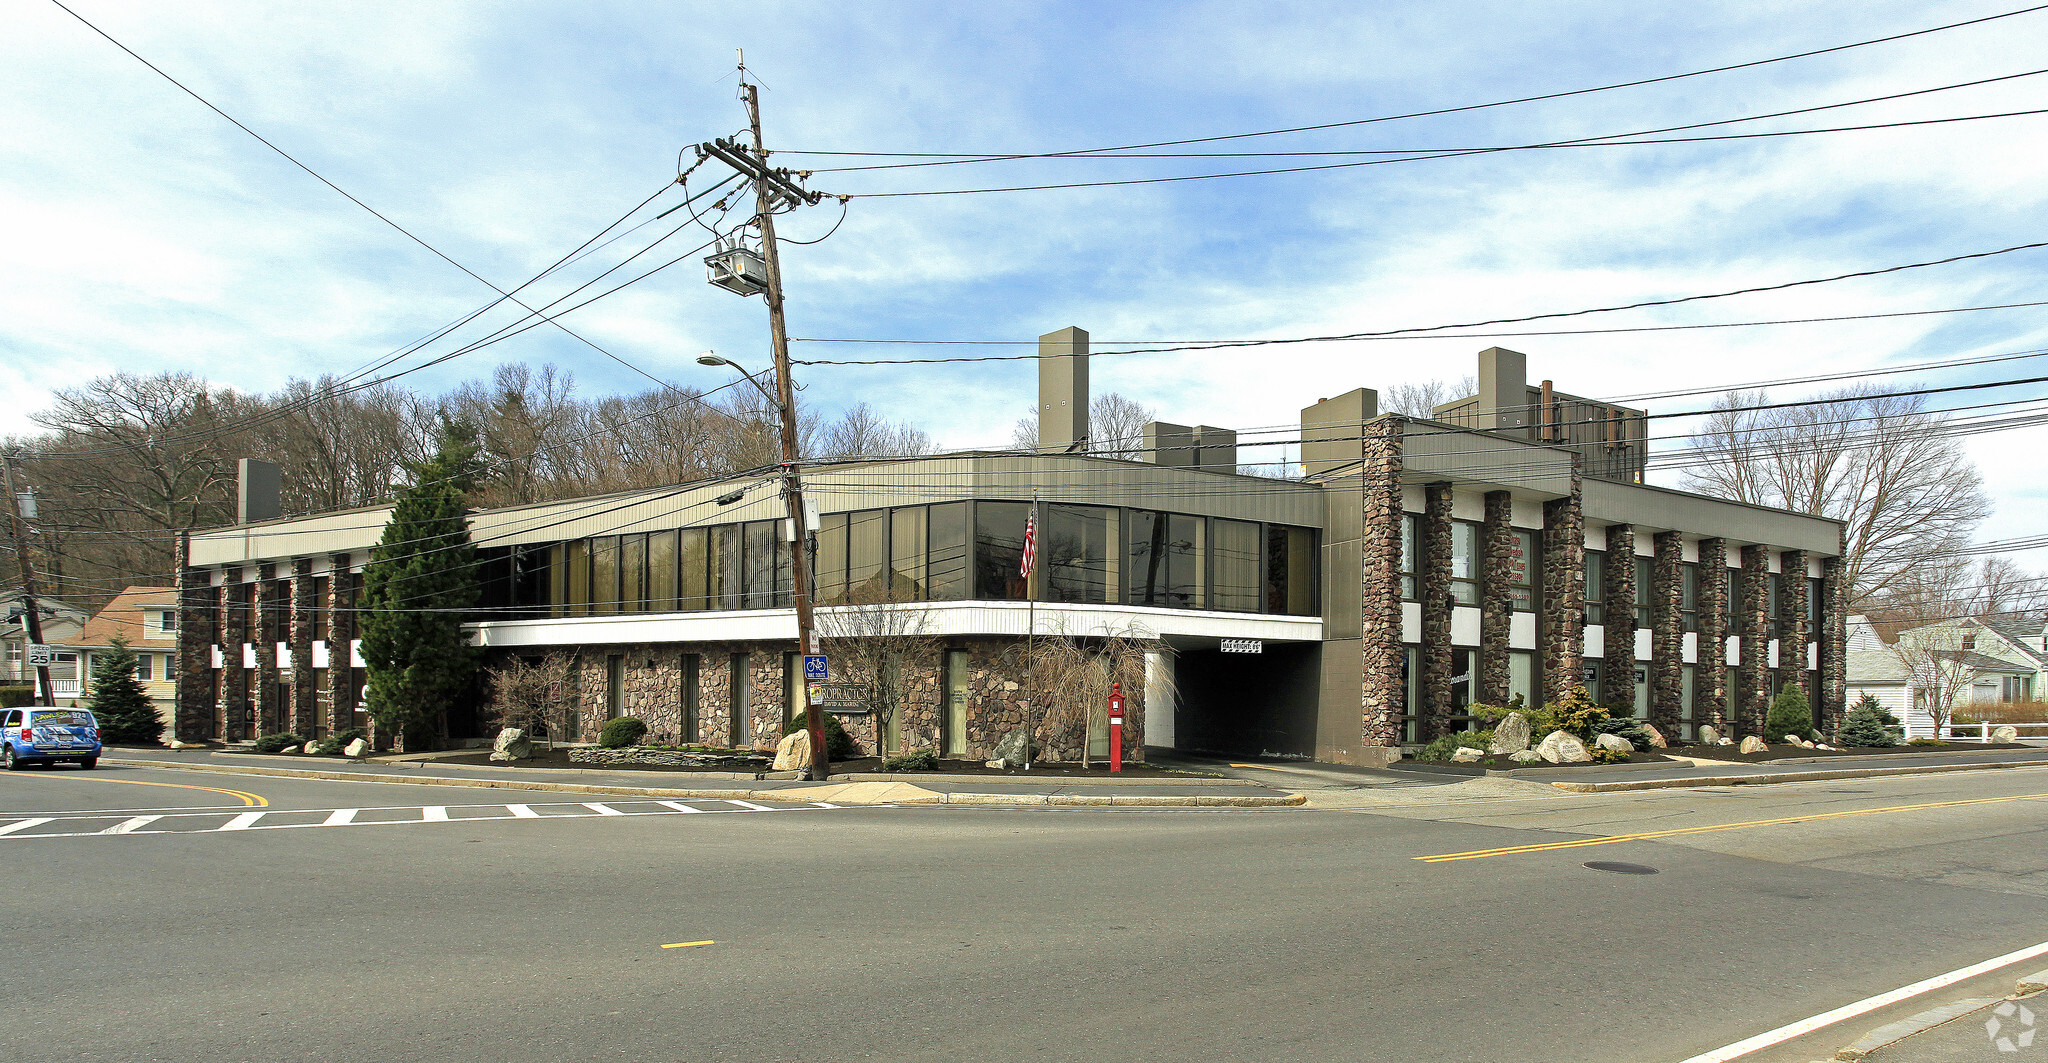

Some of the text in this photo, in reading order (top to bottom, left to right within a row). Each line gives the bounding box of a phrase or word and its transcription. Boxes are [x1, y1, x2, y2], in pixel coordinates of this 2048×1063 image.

[30, 655, 48, 663] 25
[822, 687, 868, 700] ROPRACTOR
[34, 712, 70, 721] LAWLESS
